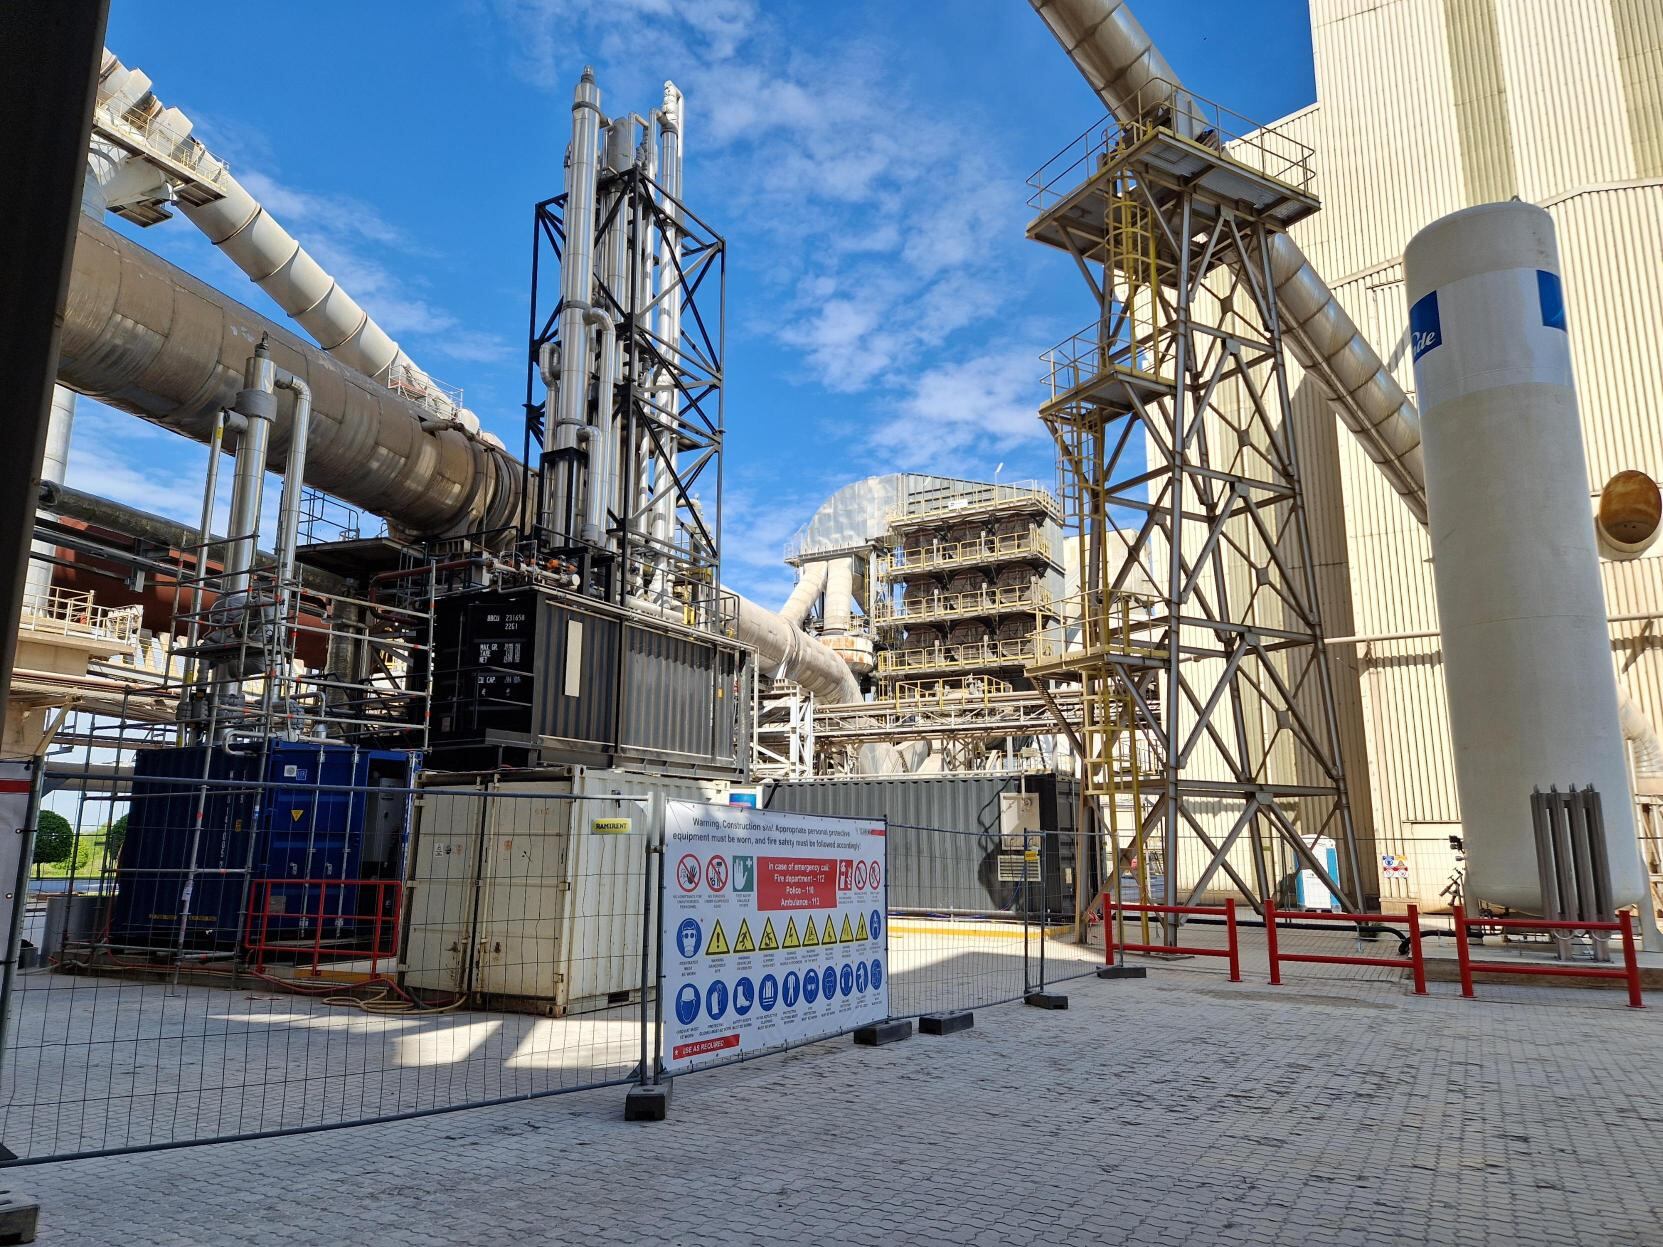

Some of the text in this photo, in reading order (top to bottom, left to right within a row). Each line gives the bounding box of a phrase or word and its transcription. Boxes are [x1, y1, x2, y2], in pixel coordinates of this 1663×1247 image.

[722, 819, 761, 831] Construction
[807, 827, 828, 837] personal
[672, 831, 710, 843] equipment
[711, 834, 727, 842] must
[727, 833, 736, 842] be
[755, 836, 766, 845] and
[767, 836, 777, 845] fire
[778, 838, 795, 848] safety
[768, 862, 774, 870] In
[788, 862, 794, 870] of
[794, 863, 820, 873] emergency
[774, 873, 785, 881] Fire
[785, 874, 813, 884] department
[817, 874, 825, 883] 112
[786, 886, 802, 895] Police
[780, 897, 809, 907] Ambulance
[693, 1044, 700, 1053] AS
[700, 1040, 725, 1052] REQUIRED
